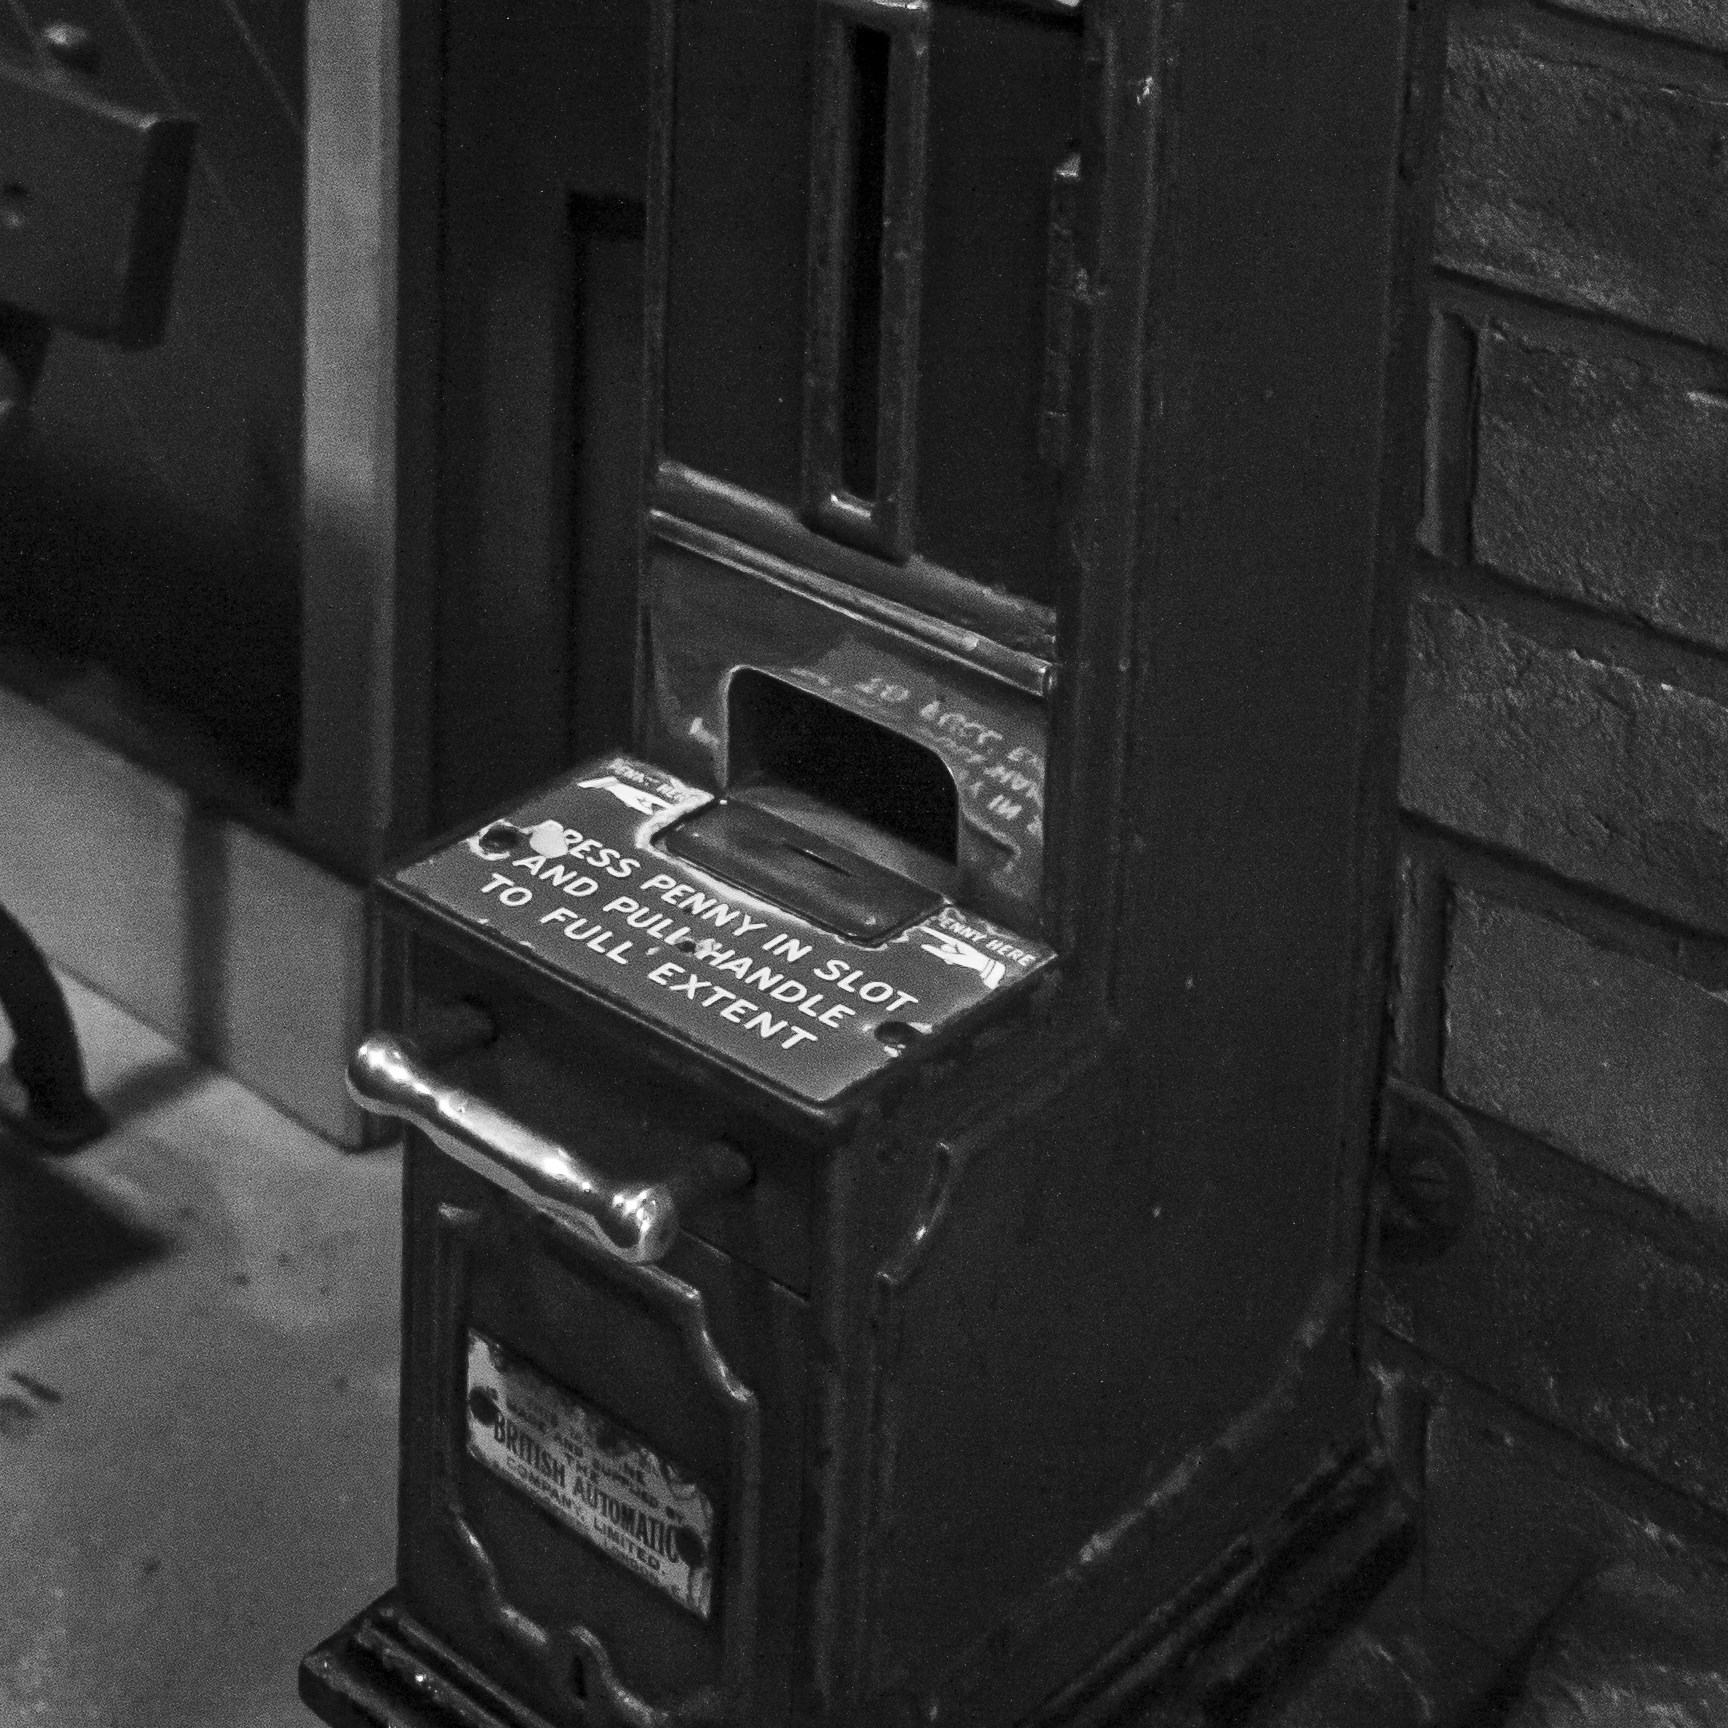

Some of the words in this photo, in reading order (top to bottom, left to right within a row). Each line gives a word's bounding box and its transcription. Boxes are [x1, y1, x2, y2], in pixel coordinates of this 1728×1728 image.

[480, 872, 533, 907] TO
[539, 906, 634, 965] FULL
[646, 960, 819, 1050] EXTENT
[511, 855, 599, 897] AND
[602, 896, 692, 946] PULL
[694, 942, 856, 1029] HANDLE
[558, 827, 641, 878] RESS
[640, 873, 768, 937] PENNY
[761, 933, 813, 963] IN
[813, 959, 919, 1012] SLOT
[939, 917, 988, 943] ENNY
[985, 939, 1037, 967] HERE
[493, 1411, 566, 1488] BRITISH
[573, 1478, 680, 1564] AUTOMATIC
